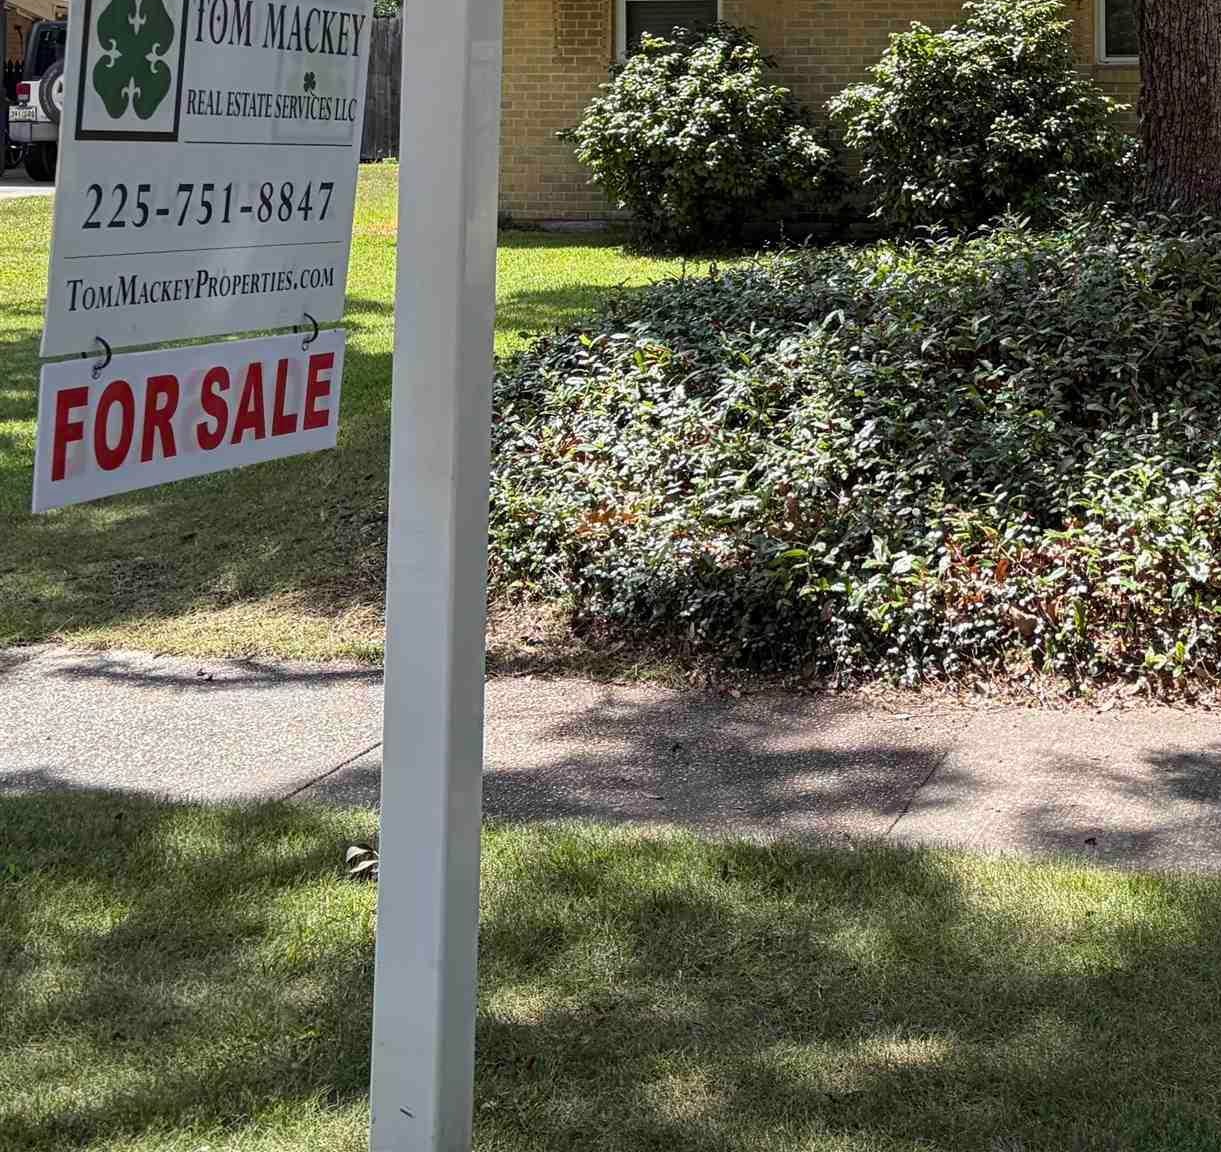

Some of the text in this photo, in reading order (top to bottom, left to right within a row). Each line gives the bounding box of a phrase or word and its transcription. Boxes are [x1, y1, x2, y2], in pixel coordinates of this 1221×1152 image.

[262, 2, 366, 57] MACKEY
[186, 89, 358, 122] REAL ESTATE SERVICES LLC
[82, 181, 335, 229] 225-751-8847
[51, 351, 335, 482] FOR SALE
